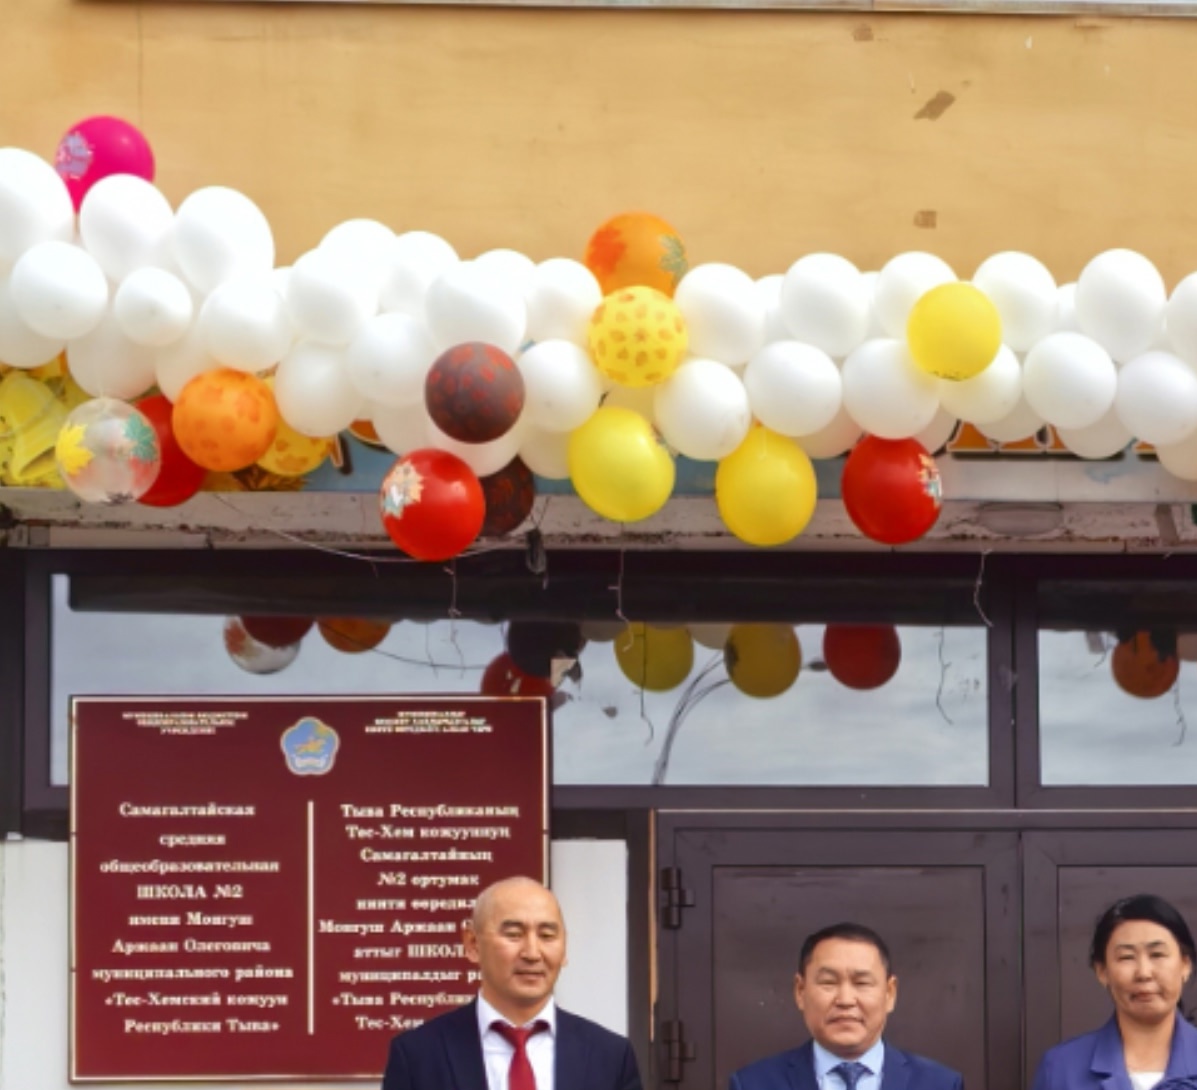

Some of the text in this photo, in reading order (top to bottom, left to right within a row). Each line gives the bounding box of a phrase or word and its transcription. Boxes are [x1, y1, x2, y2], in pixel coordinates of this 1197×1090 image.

[119, 802, 255, 816] Самагалтайская
[340, 804, 384, 818] Тыва
[345, 825, 414, 839] Тес-Хем
[159, 834, 226, 848] средняя
[100, 859, 280, 875] общеобразовательная
[377, 872, 406, 886] №2
[137, 884, 243, 899] ШКОЛА №2
[128, 912, 253, 928] имени Монгуш
[318, 919, 384, 936] Монгуш
[390, 919, 456, 936] Аржаан
[111, 937, 271, 955] Аржаан Олеговича
[407, 944, 464, 959] ШКОЛ
[92, 965, 294, 983] муниципального района
[227, 994, 288, 1008] кожуун
[124, 1019, 221, 1035] Республики
